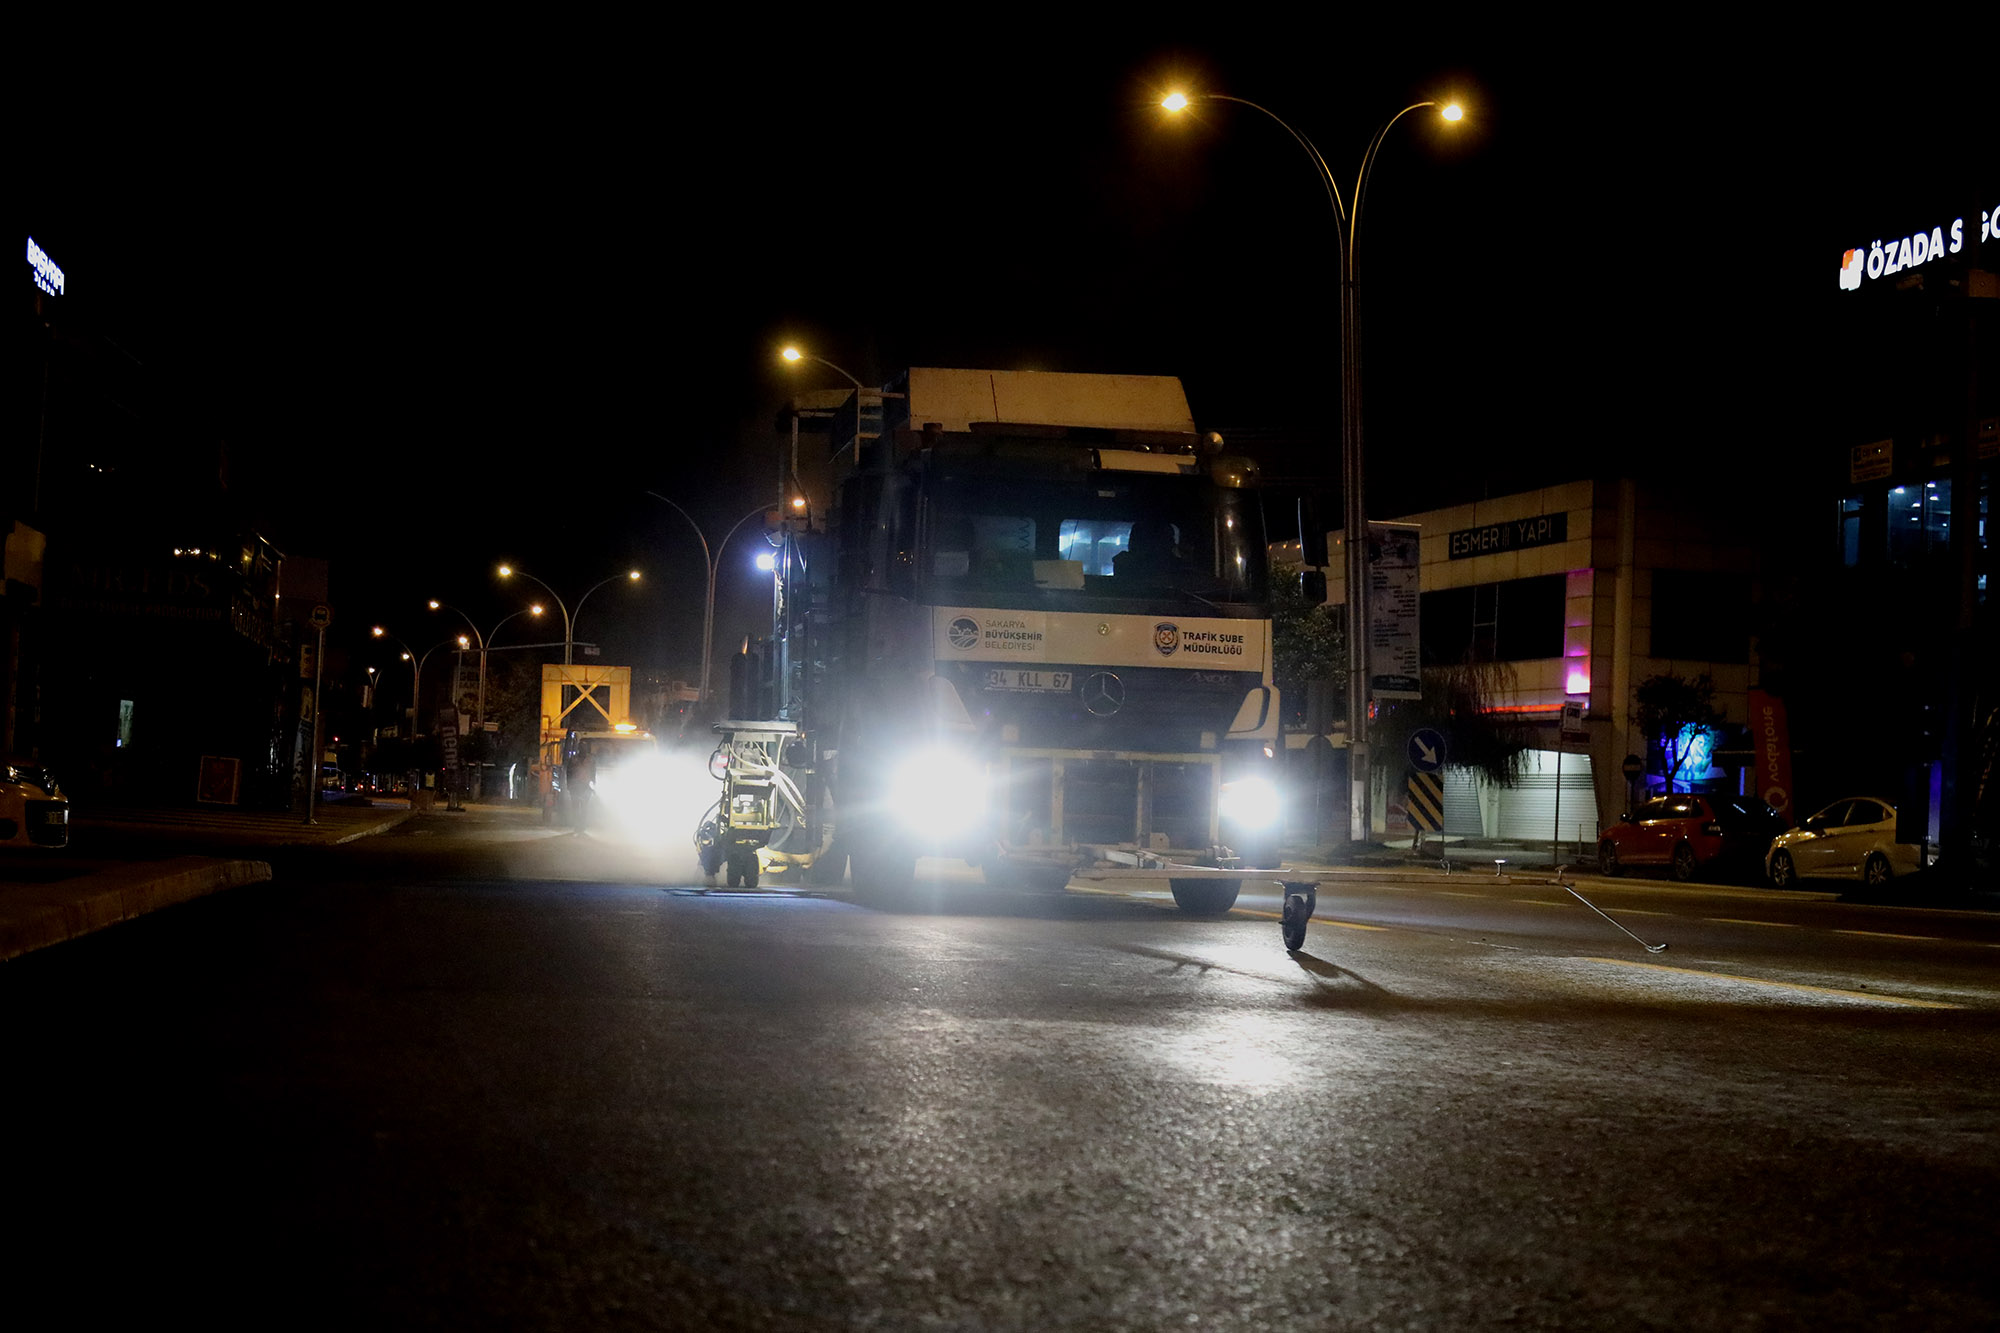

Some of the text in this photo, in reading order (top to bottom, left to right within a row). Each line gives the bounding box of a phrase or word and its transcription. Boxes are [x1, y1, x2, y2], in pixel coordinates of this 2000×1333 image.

[1867, 226, 1945, 280] ÖZADA
[1452, 518, 1552, 555] ESMER YAPI
[985, 619, 1026, 629] SAKARYA
[985, 629, 1042, 641] BÜYÜKŞEHİR
[1182, 631, 1244, 644] TRAFİK ŞUBE
[1183, 642, 1243, 656] MÜDÜRLÜĞÜ
[990, 671, 1070, 689] 34 KLL 67
